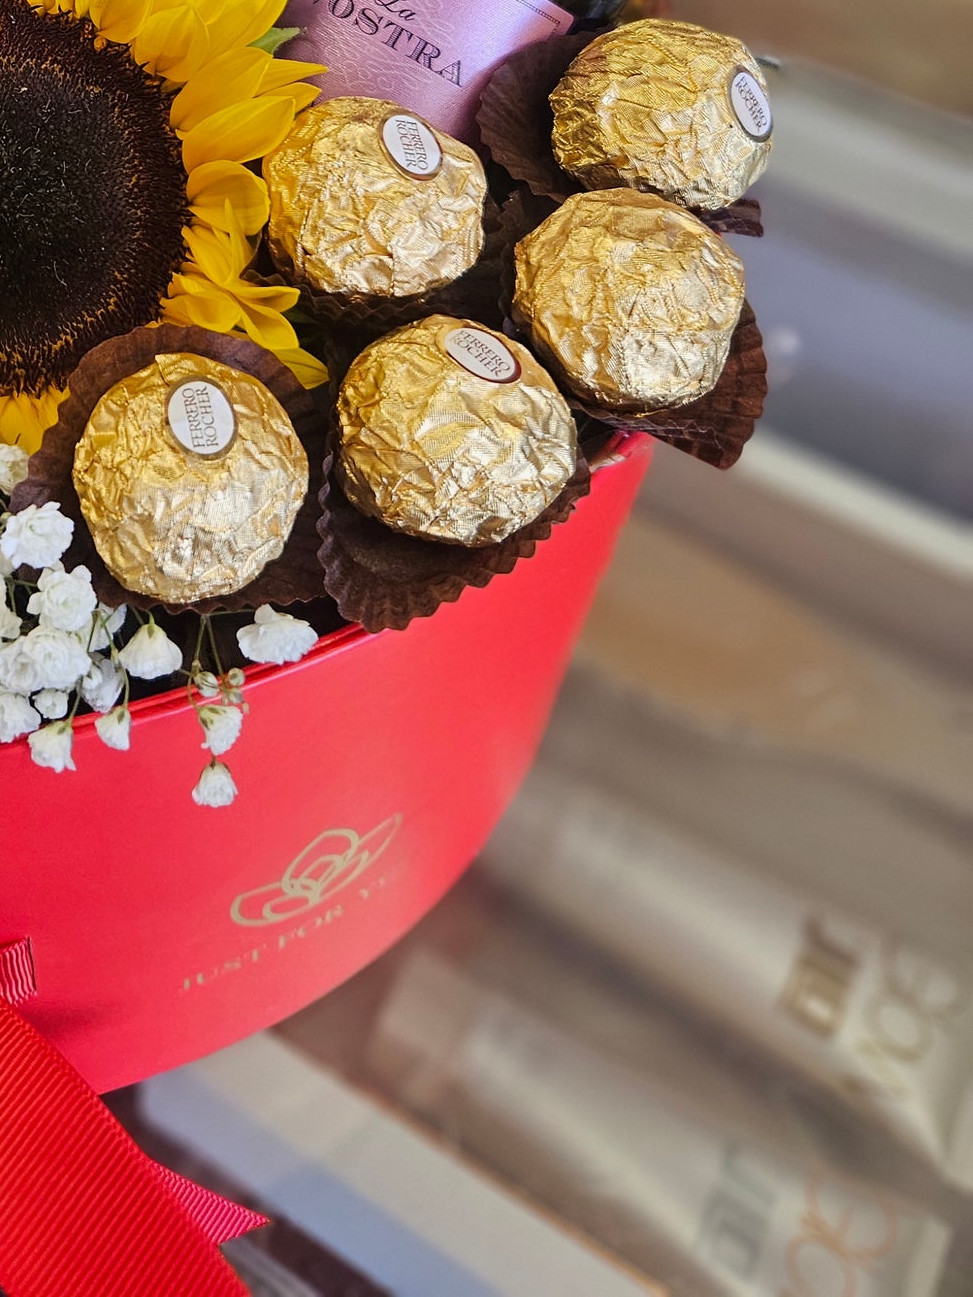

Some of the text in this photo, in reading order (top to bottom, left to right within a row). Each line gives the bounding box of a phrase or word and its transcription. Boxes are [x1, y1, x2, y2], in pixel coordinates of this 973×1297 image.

[735, 81, 762, 132] ROCHER
[740, 76, 767, 126] FERRERO
[395, 119, 417, 167] ROCHER
[406, 121, 428, 171] FERRERO
[449, 336, 502, 377] ROCHER
[457, 330, 510, 372] FERRERO
[181, 387, 206, 448] FERRERO
[195, 385, 219, 447] ROCHER
[178, 942, 268, 993] JUST
